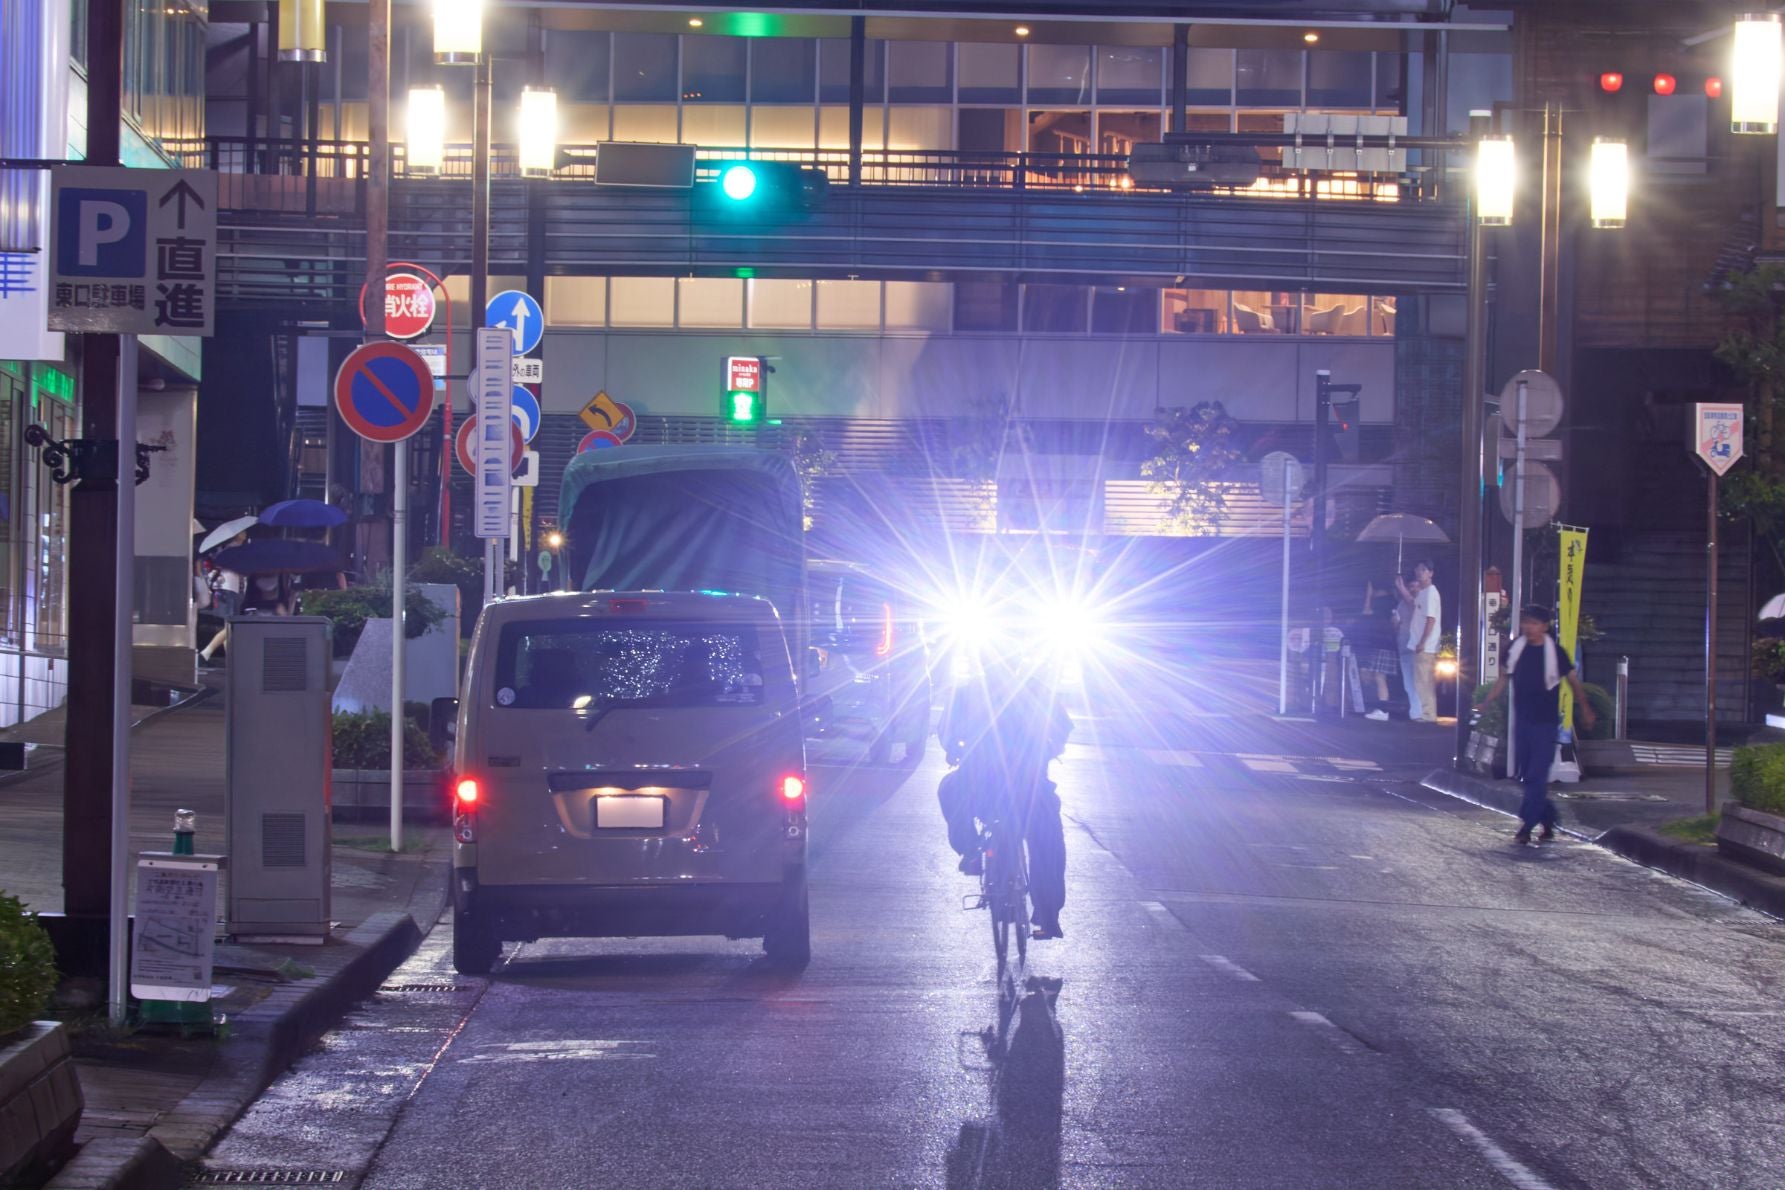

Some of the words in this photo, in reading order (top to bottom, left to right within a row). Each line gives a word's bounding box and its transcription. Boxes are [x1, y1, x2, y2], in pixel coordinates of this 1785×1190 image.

[78, 199, 131, 266] P
[56, 282, 145, 311] 東口駐車場
[154, 236, 206, 328] 直進
[512, 364, 540, 379] 外の車両
